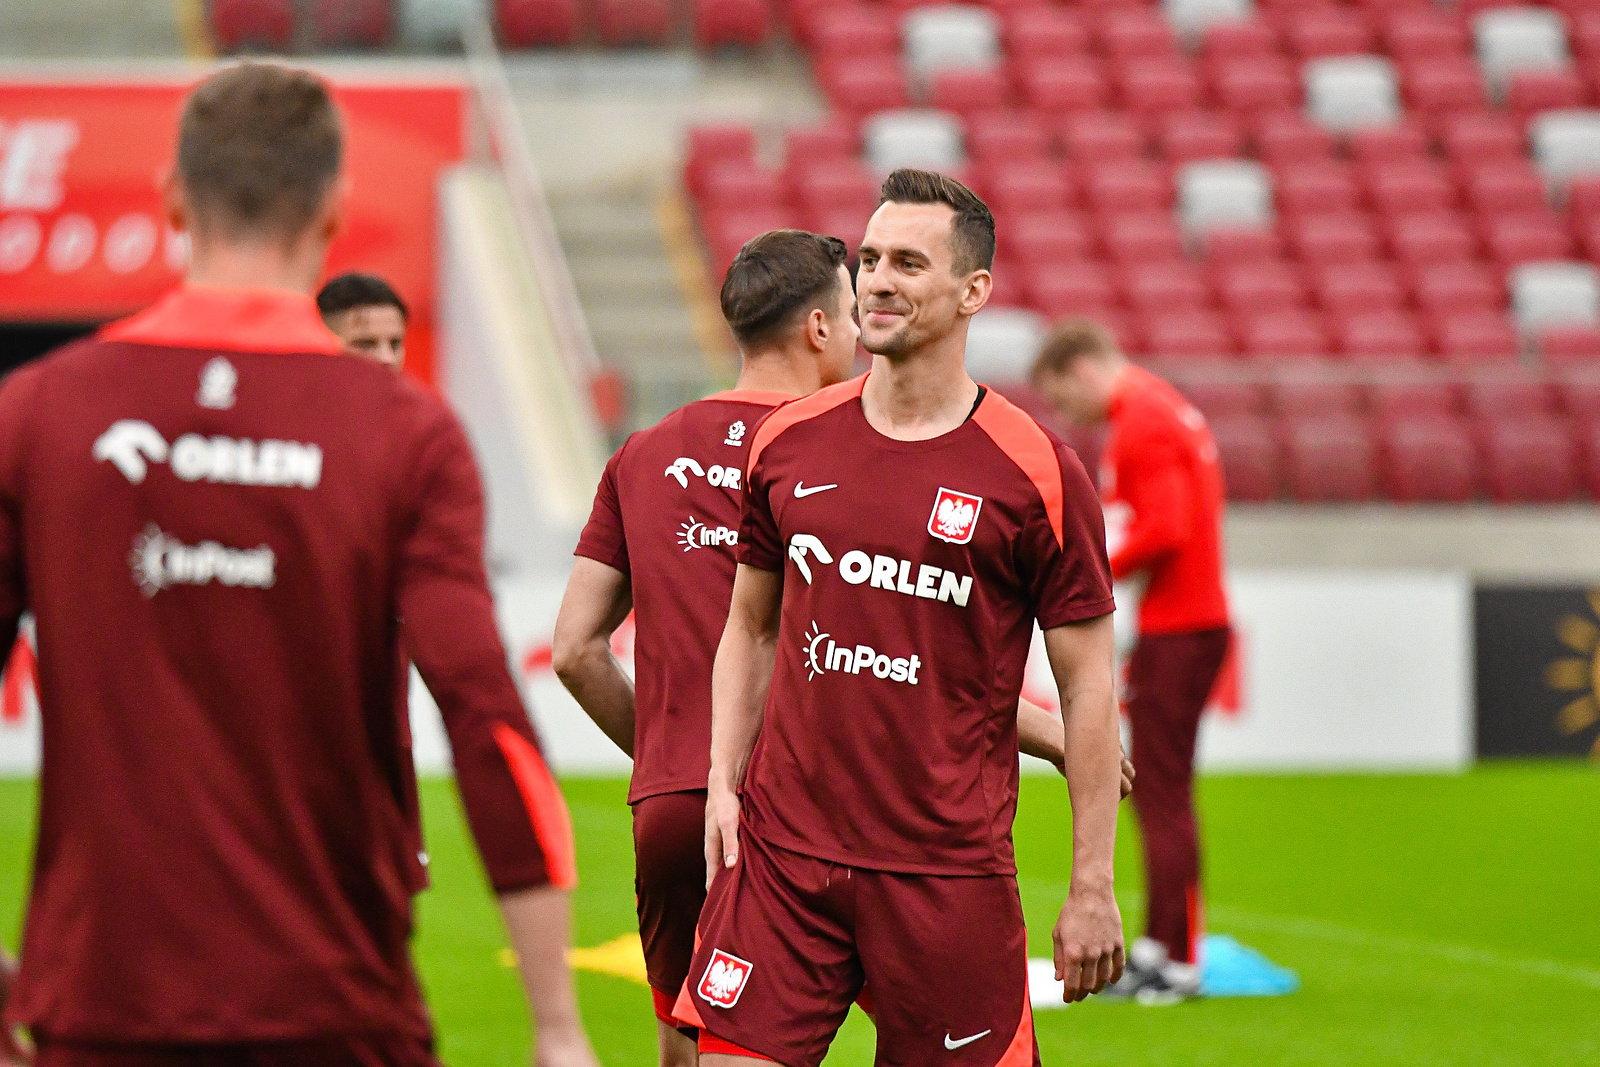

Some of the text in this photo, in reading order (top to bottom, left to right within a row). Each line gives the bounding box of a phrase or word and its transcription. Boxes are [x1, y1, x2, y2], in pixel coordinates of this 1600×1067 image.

[170, 433, 323, 489] ORLEN
[707, 465, 742, 491] OR
[700, 526, 739, 546] InPo
[165, 541, 276, 588] InPost
[839, 550, 973, 608] ORLEN
[824, 639, 921, 685] InPost
